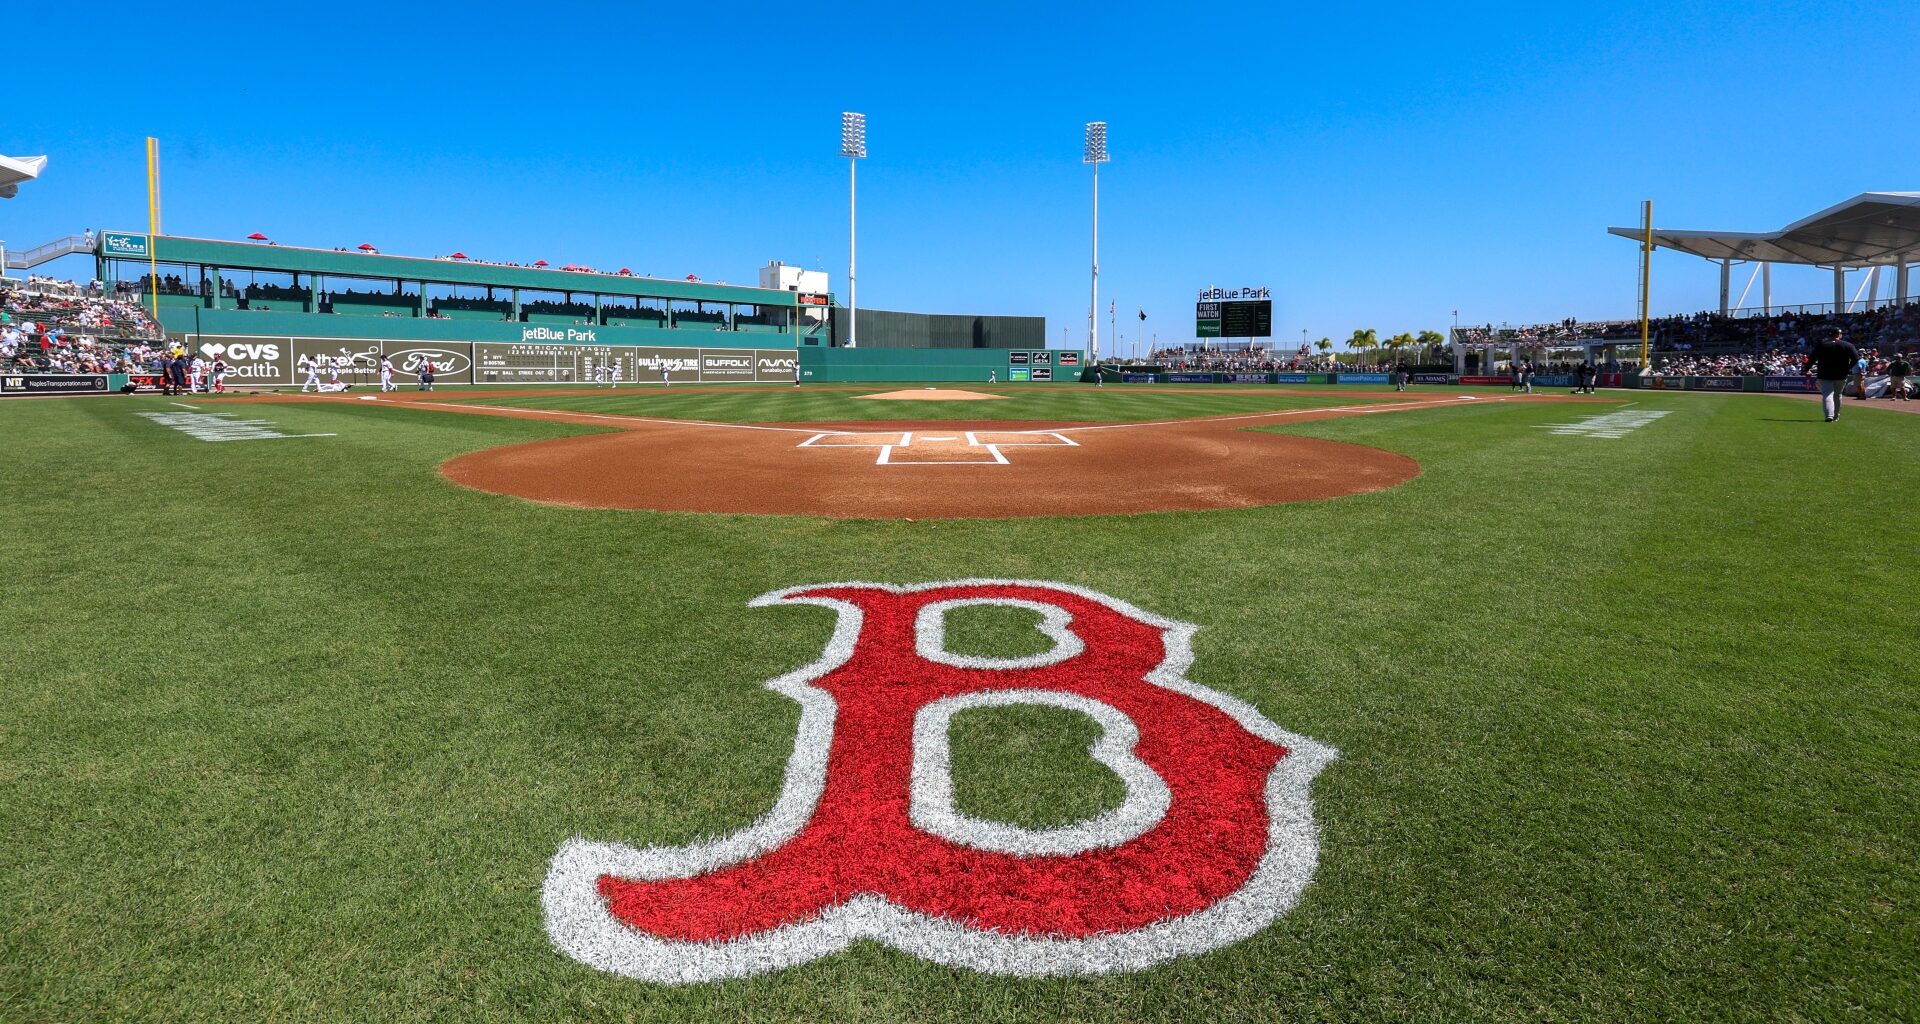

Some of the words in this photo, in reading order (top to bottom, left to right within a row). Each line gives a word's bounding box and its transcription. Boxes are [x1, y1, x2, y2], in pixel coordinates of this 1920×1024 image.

[1198, 288, 1238, 302] jetBlue
[1242, 287, 1270, 298] Park
[522, 327, 564, 342] jetBlue
[568, 329, 596, 342] Park
[227, 343, 280, 360] CVS
[402, 352, 456, 372] Frd
[638, 354, 673, 366] SULLIVAN
[684, 358, 698, 366] TIRE
[758, 358, 796, 367] nuna
[1554, 376, 1568, 385] CAFE
[542, 578, 1339, 984] B
